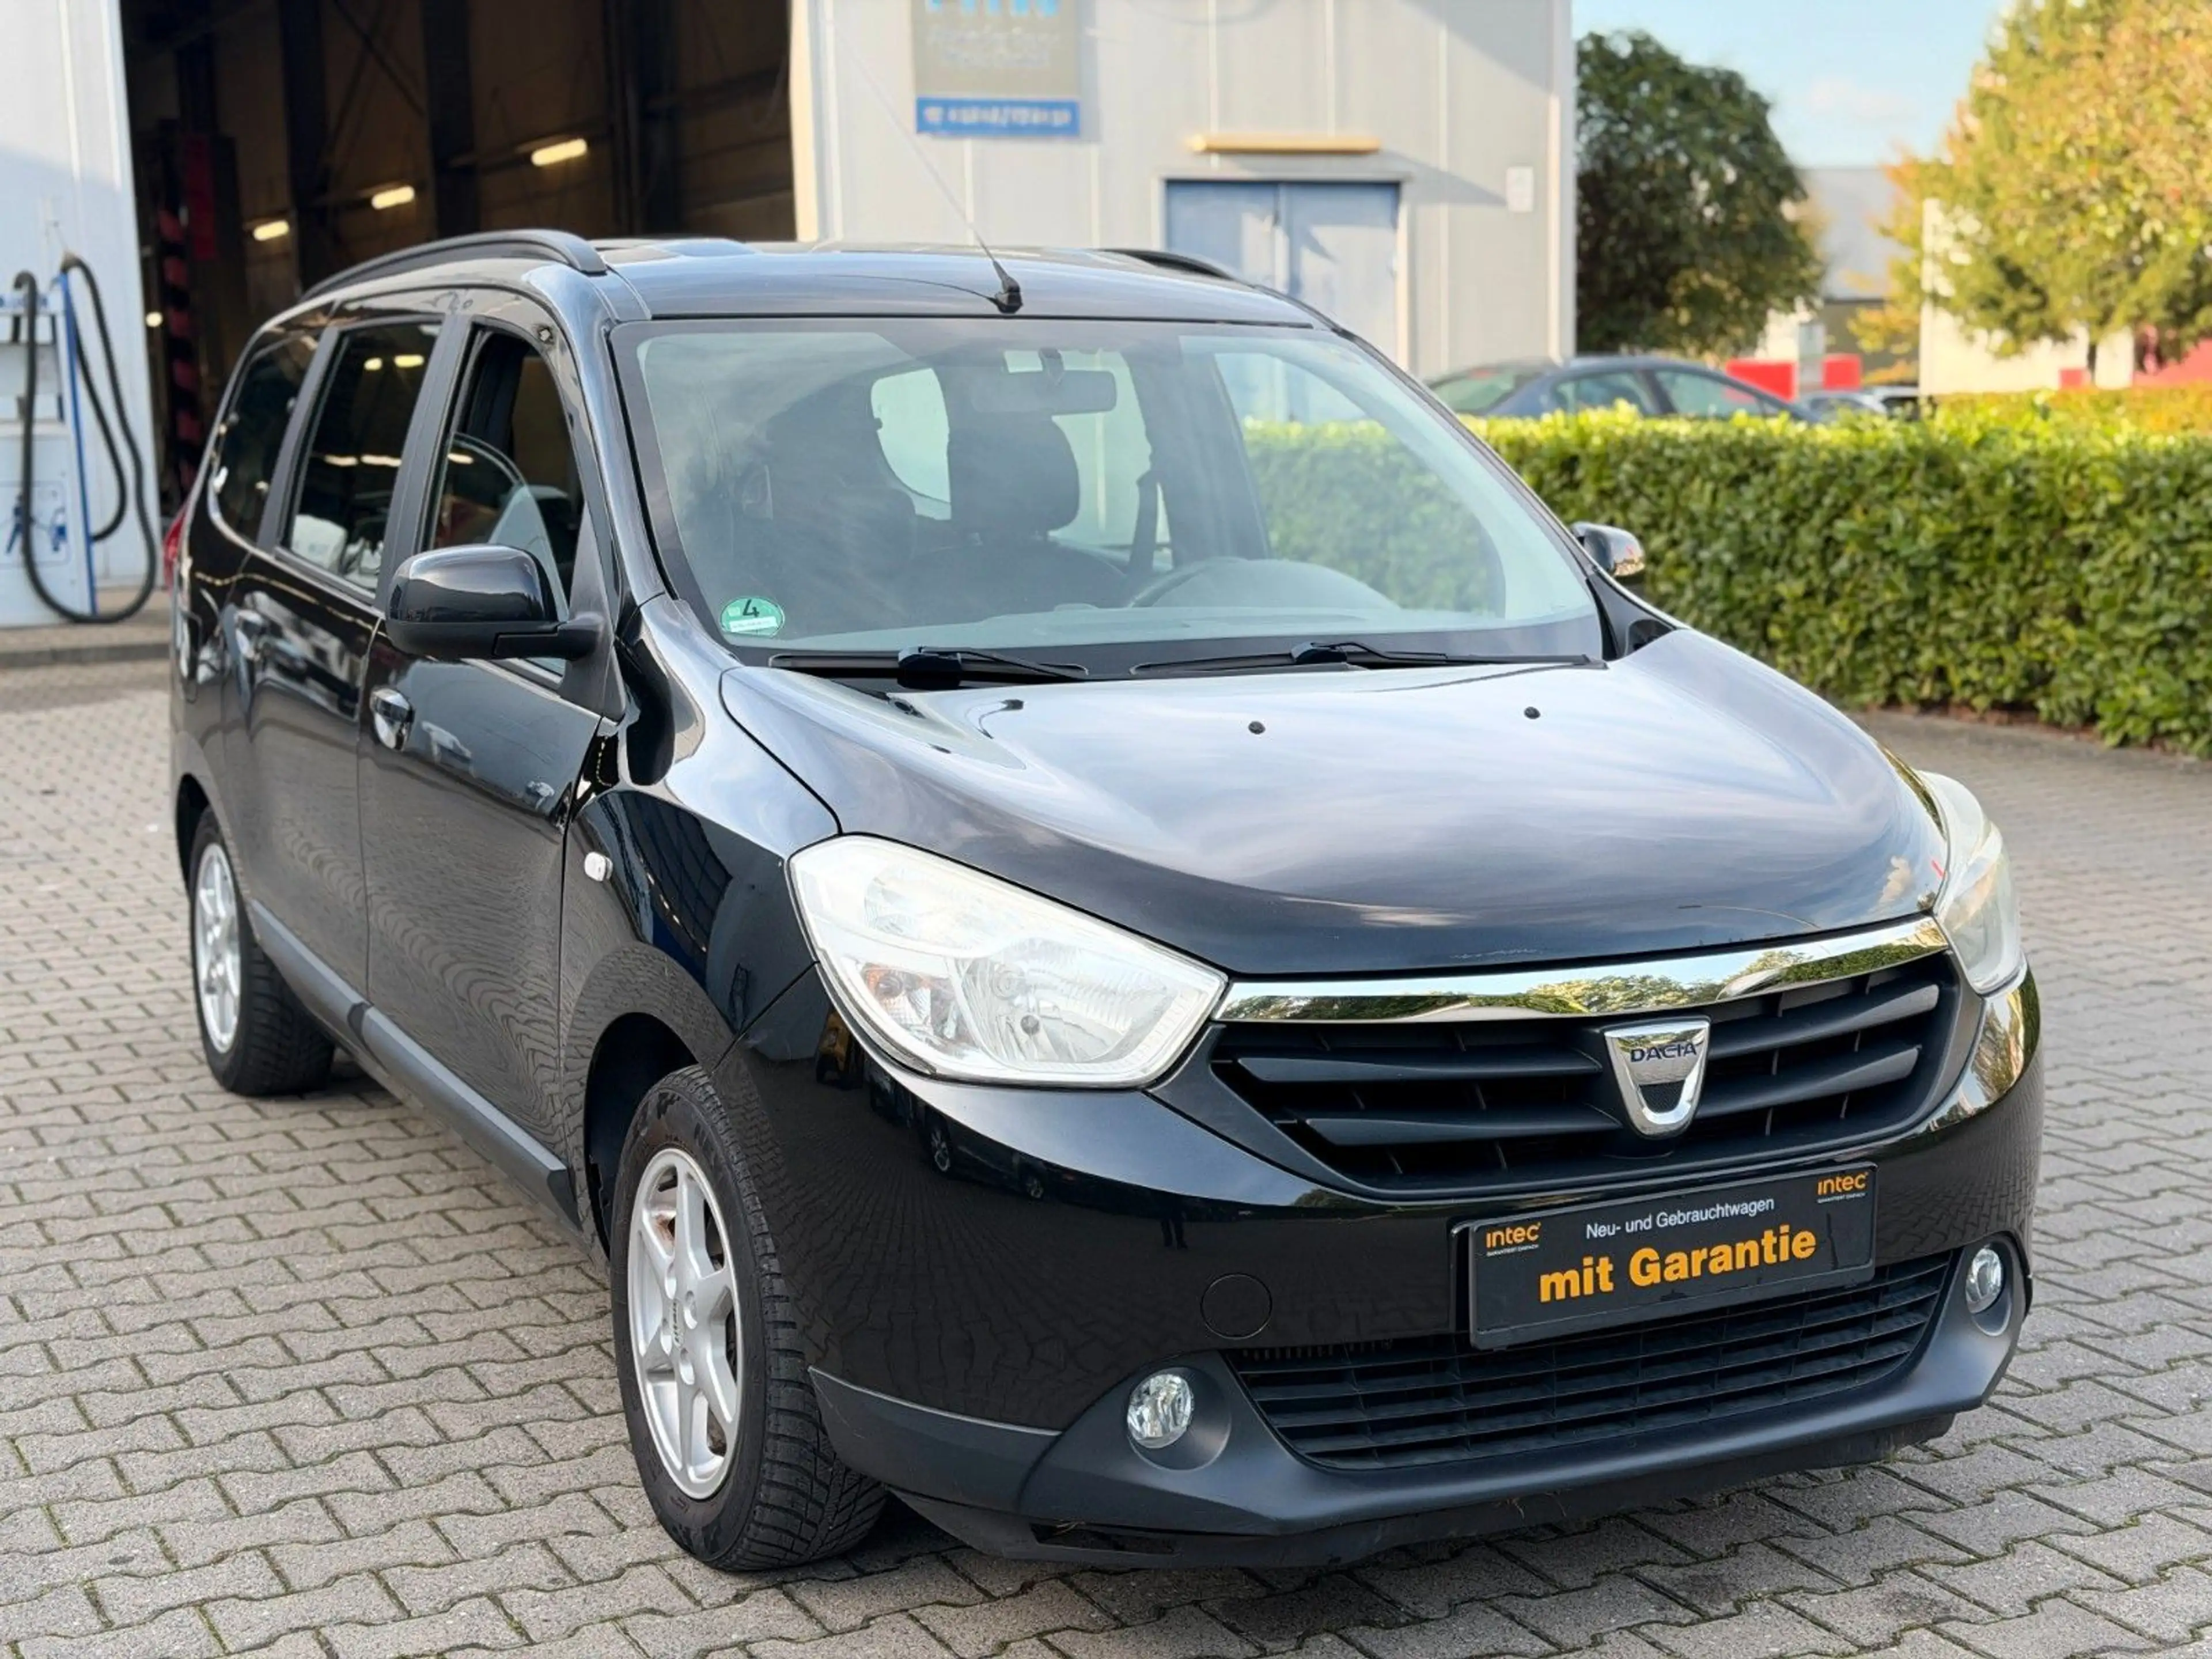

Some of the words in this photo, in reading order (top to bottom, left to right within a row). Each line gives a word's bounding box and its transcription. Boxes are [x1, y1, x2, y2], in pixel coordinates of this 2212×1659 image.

[743, 599, 760, 618] 4
[1630, 1042, 1697, 1063] DACIA
[1817, 1173, 1866, 1195] intec
[1586, 1223, 1622, 1239] Neu-
[1625, 1214, 1653, 1233] und
[1656, 1198, 1775, 1228] Gebrauchtwagen
[1486, 1225, 1540, 1248] intec
[1539, 1256, 1615, 1302] mit
[1628, 1224, 1817, 1287] Garantie
